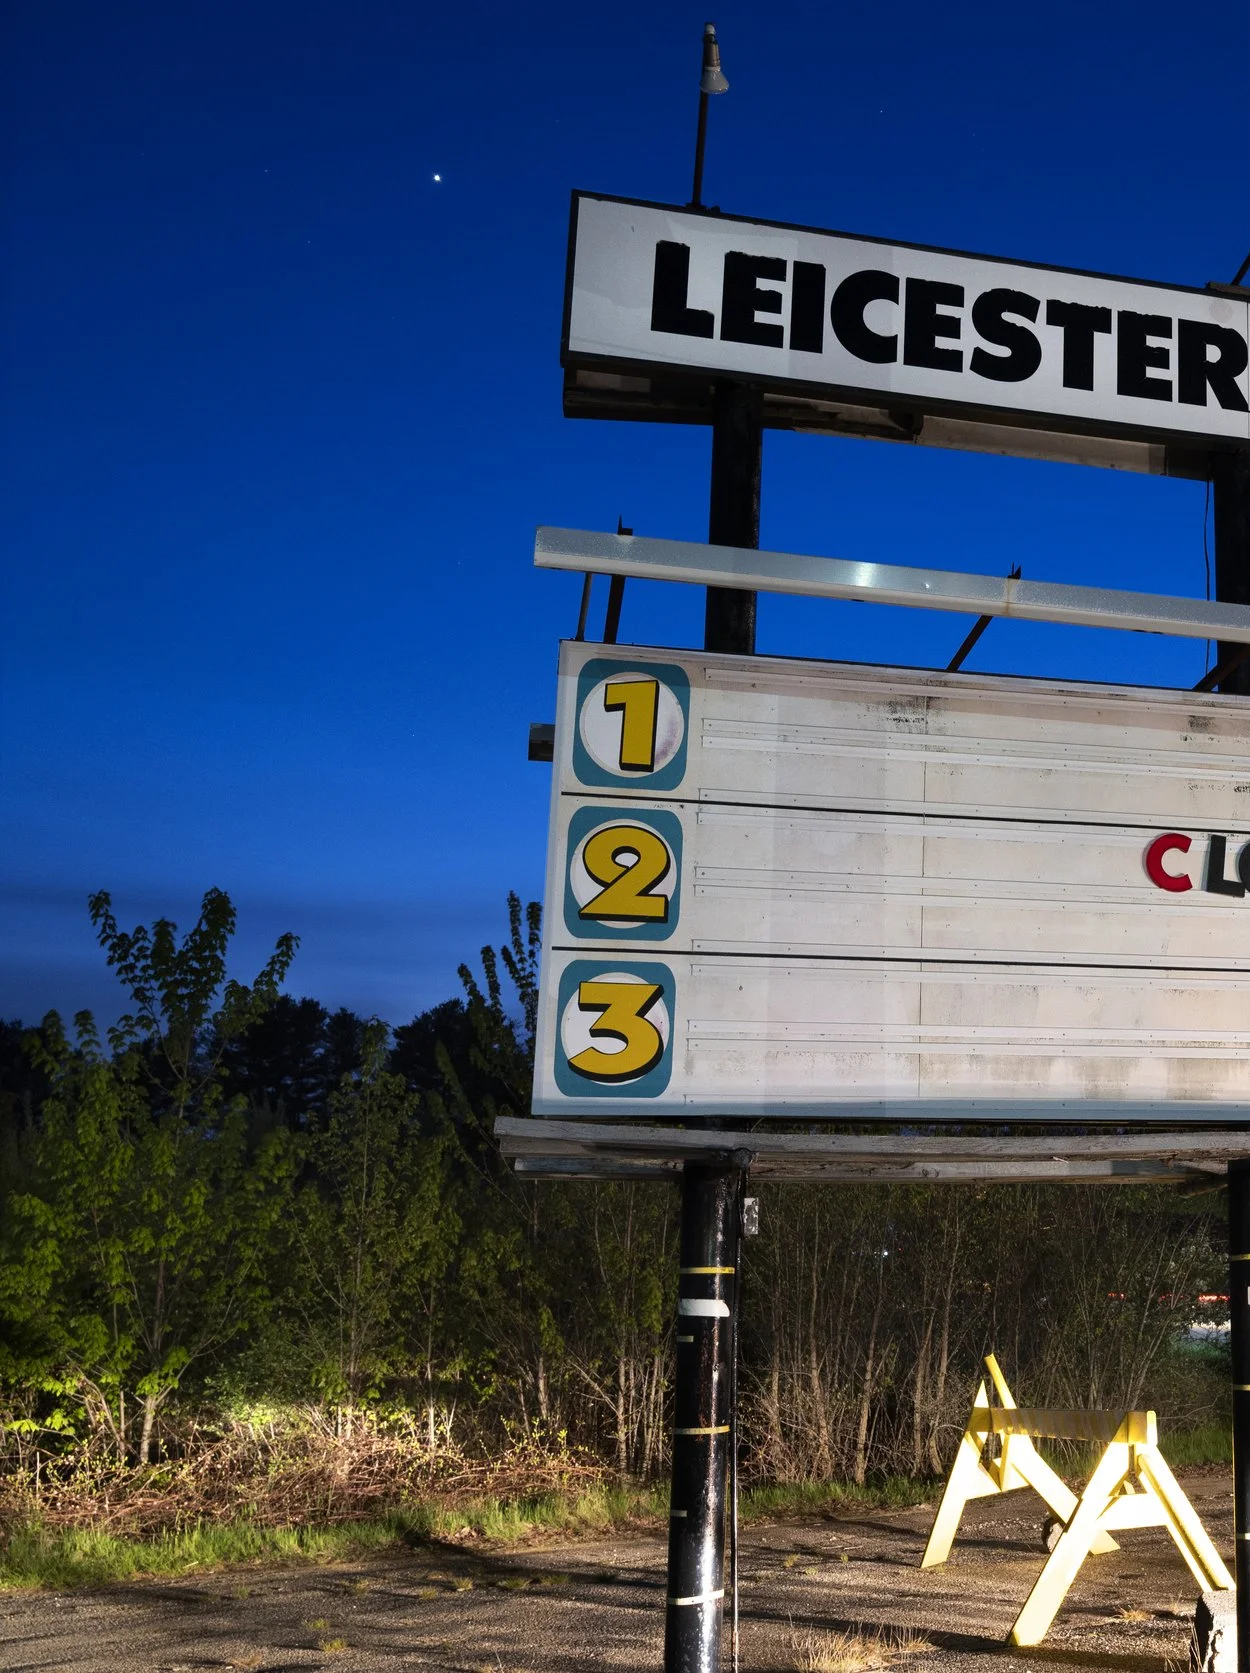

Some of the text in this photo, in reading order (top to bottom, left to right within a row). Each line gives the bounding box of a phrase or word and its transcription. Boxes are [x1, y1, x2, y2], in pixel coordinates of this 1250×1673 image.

[604, 679, 660, 772] 1
[578, 825, 671, 923] 2
[567, 981, 664, 1083] 3
